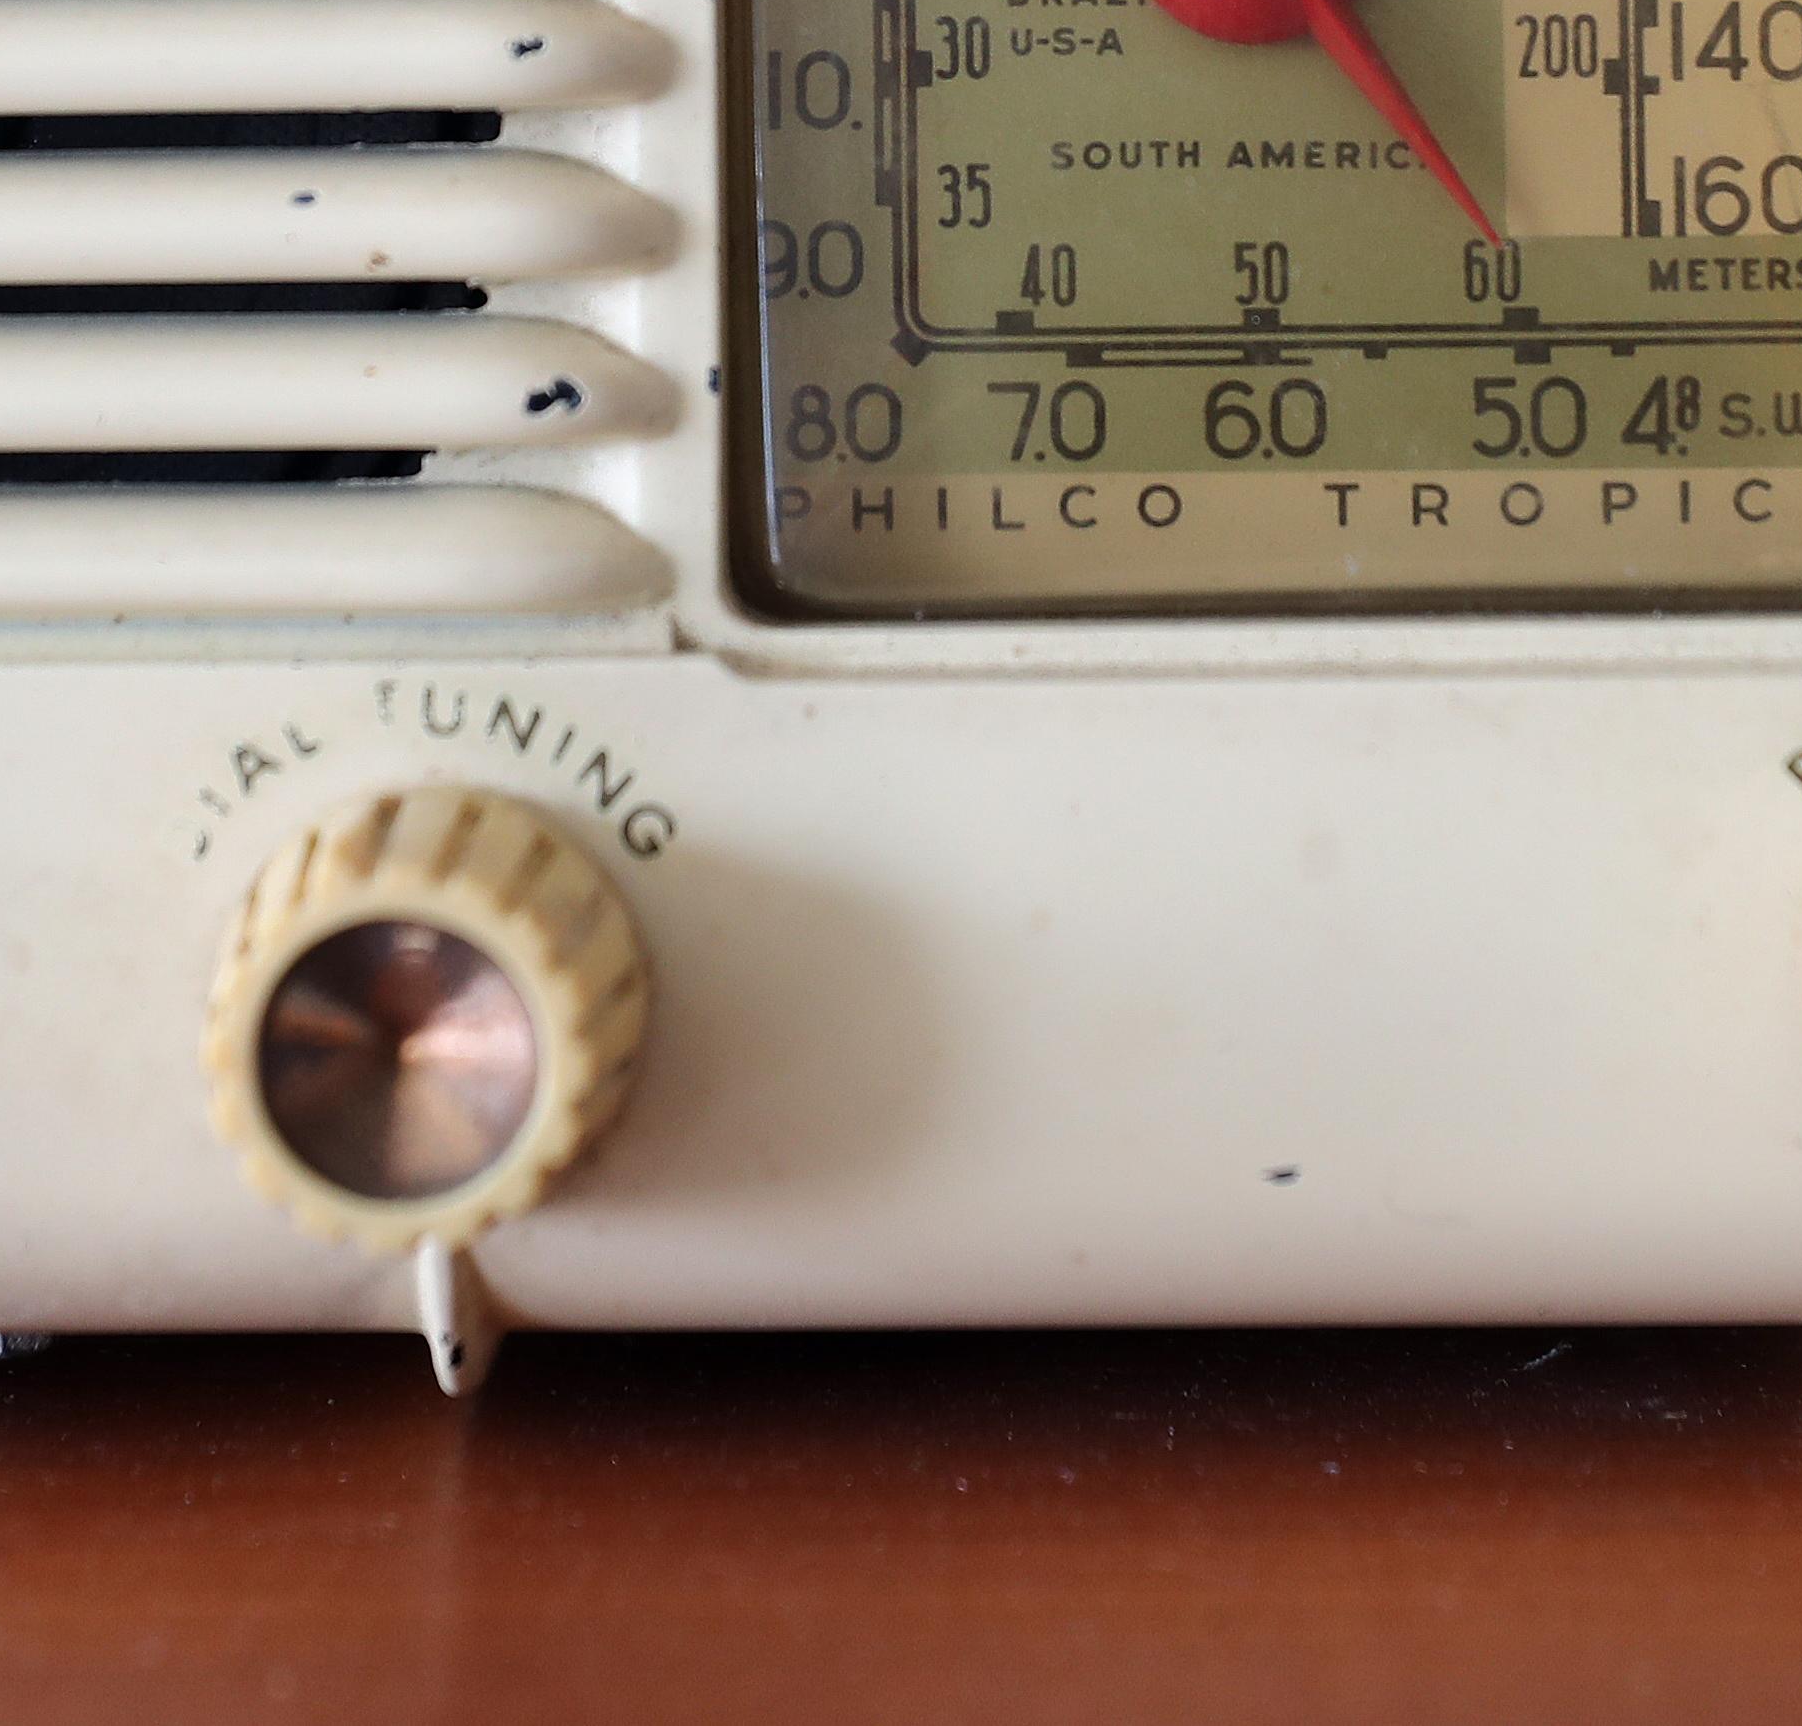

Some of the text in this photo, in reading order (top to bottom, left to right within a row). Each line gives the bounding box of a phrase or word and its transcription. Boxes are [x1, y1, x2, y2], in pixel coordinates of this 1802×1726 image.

[935, 16, 991, 80] 30
[1010, 27, 1124, 56] U-S-A
[1515, 14, 1598, 79] 200
[1050, 139, 1428, 171] SOUTH AMERIC
[937, 164, 992, 229] 35
[1020, 238, 1522, 307] 40 50 60
[785, 382, 903, 463] 8.0
[987, 379, 1107, 462] 7.0
[1204, 378, 1328, 460] 6.0
[1472, 375, 1588, 458] 5.0
[774, 479, 1774, 532] PHILCO TROPIC
[375, 679, 677, 861] TUNING
